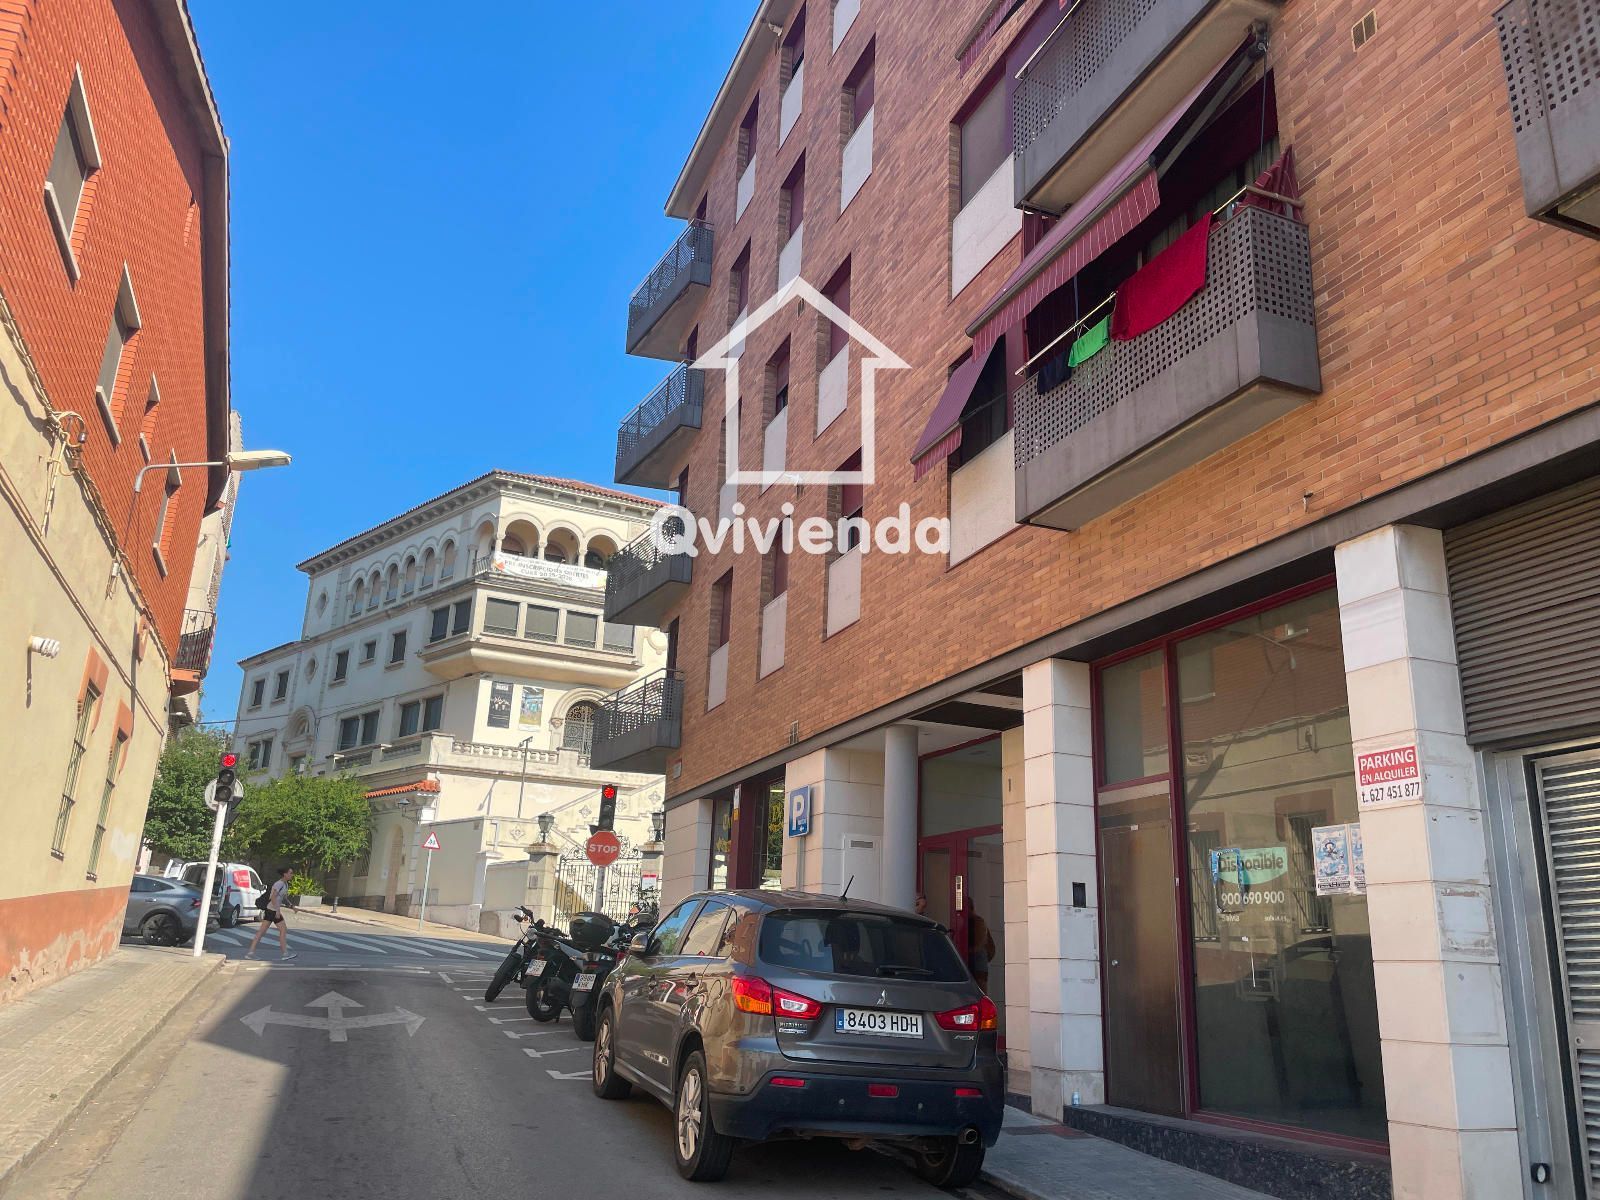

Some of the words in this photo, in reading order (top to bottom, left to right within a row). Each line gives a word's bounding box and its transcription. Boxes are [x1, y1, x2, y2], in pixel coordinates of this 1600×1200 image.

[1360, 749, 1414, 771] PARKING
[1361, 774, 1373, 784] EN
[1374, 766, 1417, 782] ALQUILER
[1370, 787, 1384, 802] 627
[1386, 784, 1403, 799] 451
[1404, 782, 1420, 797] 877
[792, 794, 805, 831] P
[589, 844, 618, 854] STOP
[1221, 892, 1240, 905] 900
[1243, 891, 1262, 905] 690
[1263, 891, 1285, 904] 900
[847, 1012, 886, 1030] 8403
[891, 1015, 919, 1033] HDH
